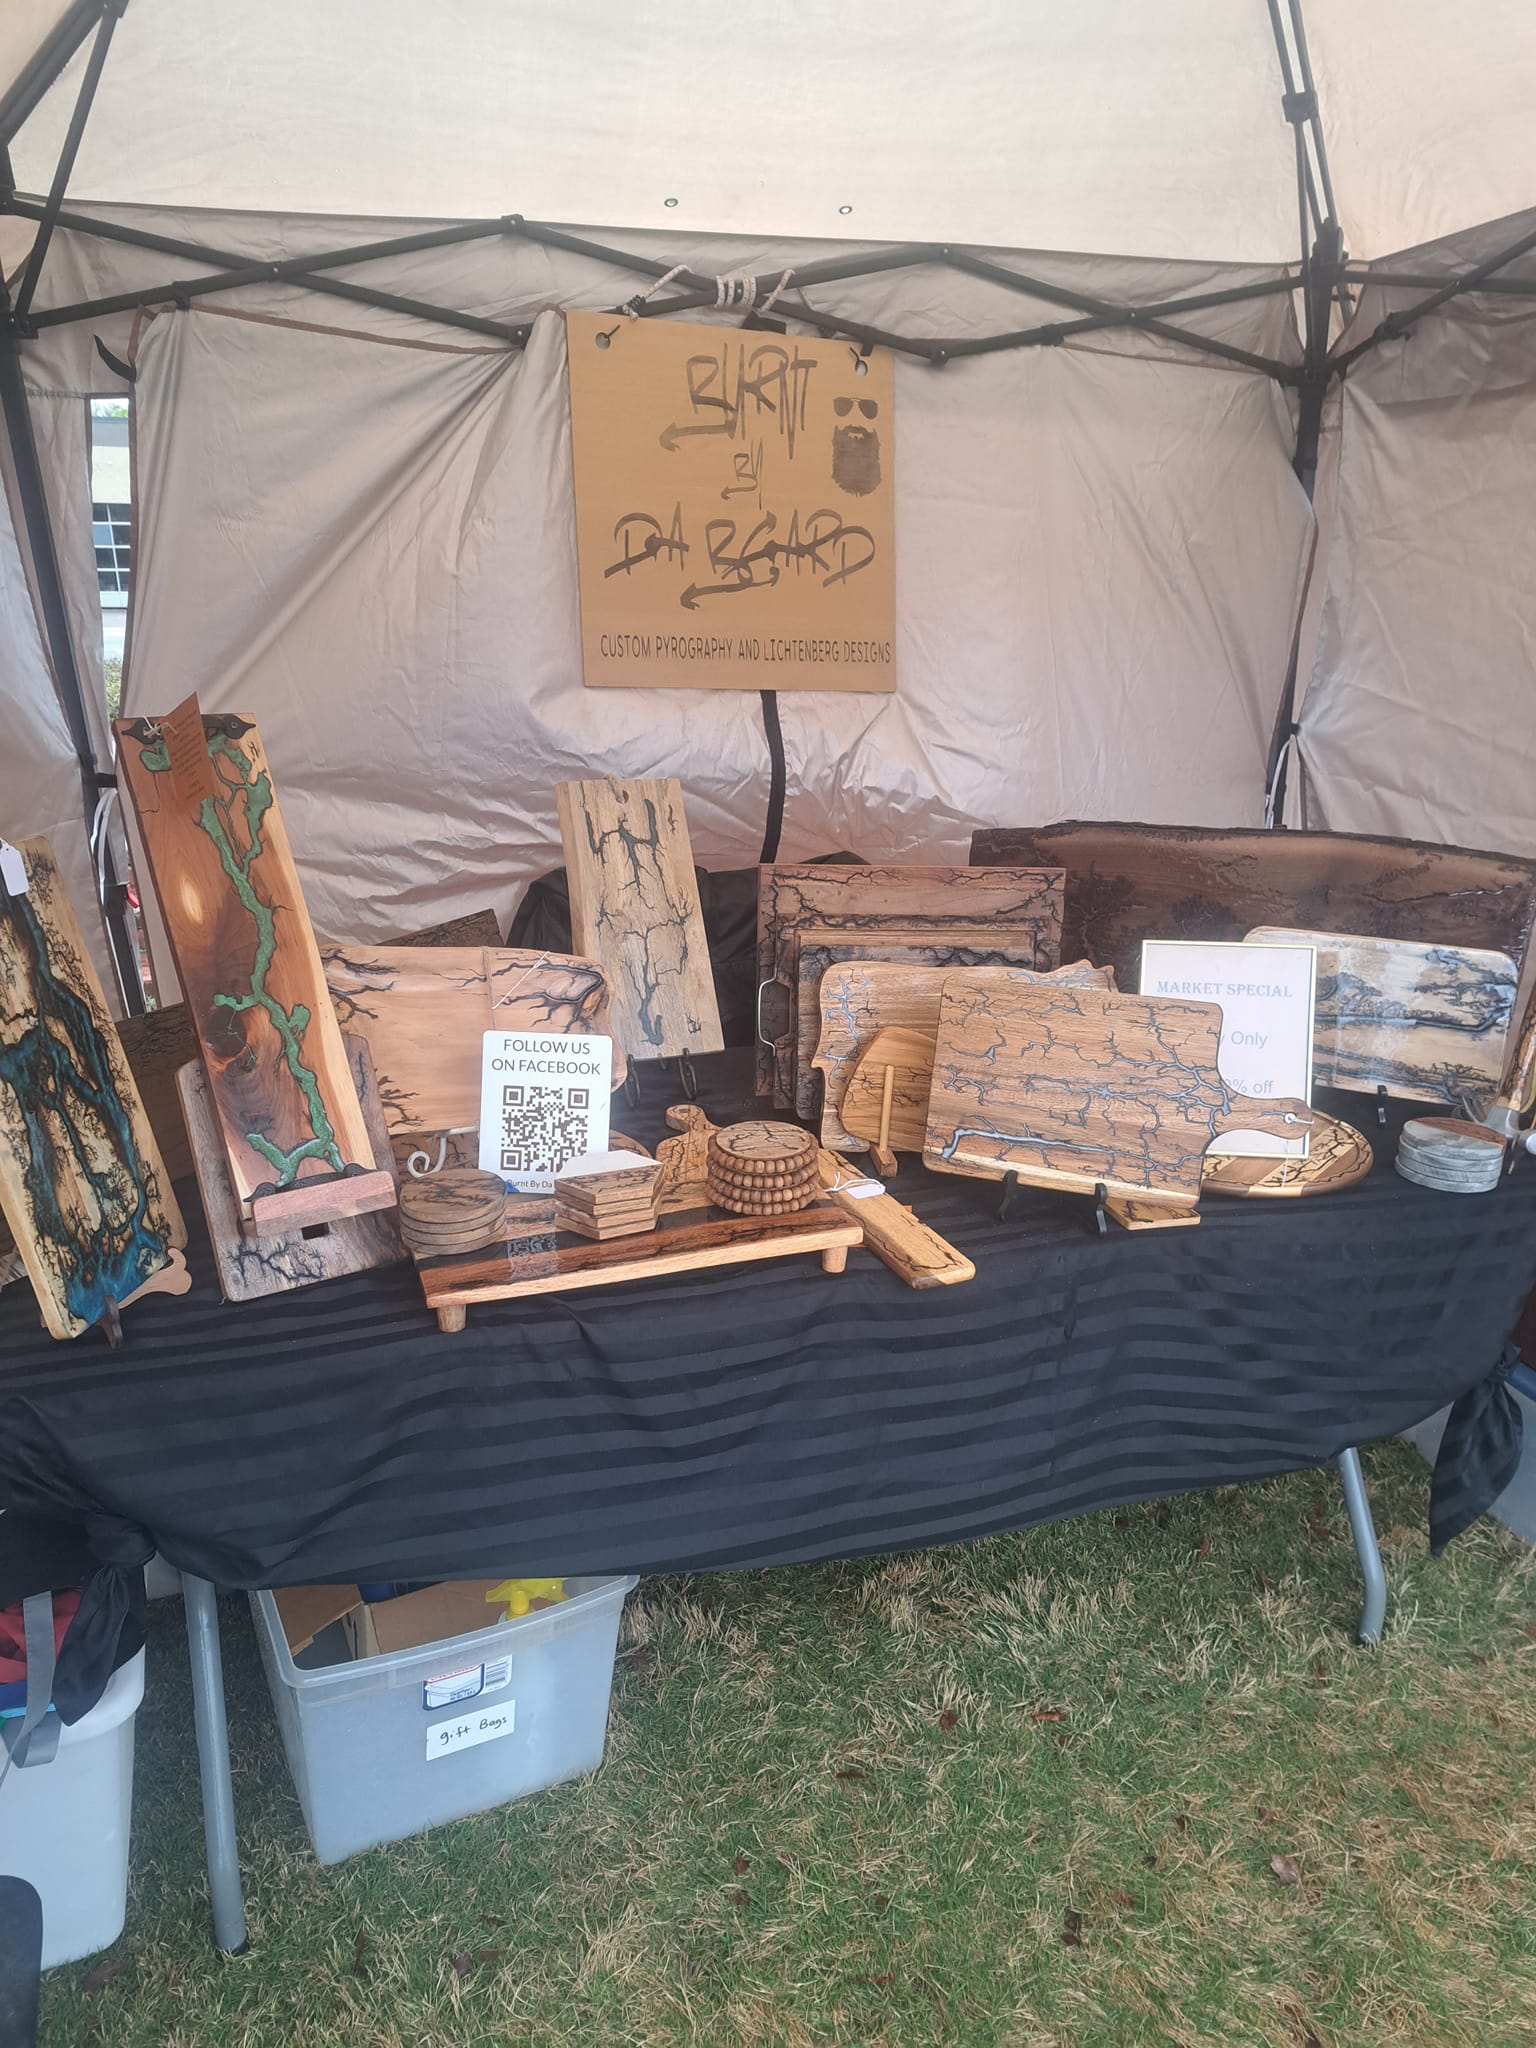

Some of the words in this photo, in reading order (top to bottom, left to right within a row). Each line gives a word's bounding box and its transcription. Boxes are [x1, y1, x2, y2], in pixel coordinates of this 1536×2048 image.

[660, 343, 818, 460] BURNT
[721, 438, 763, 511] BY
[604, 501, 690, 579] DA
[600, 634, 651, 658] CUSTOM
[655, 636, 733, 660] PYROGRAPHY
[738, 639, 760, 661] AND
[763, 639, 840, 662] LICHTENBERG
[844, 641, 891, 663] DESIGNS
[1157, 981, 1223, 995] MARKET
[1226, 984, 1293, 998] SPECIAL
[504, 1039, 568, 1054] FOLLOW
[571, 1042, 591, 1055] US
[1231, 1031, 1268, 1049] Only
[491, 1058, 515, 1072] ON
[519, 1060, 601, 1075] FACEBOOK
[1253, 1080, 1273, 1094] off
[530, 1180, 540, 1189] By
[440, 1726, 471, 1746] gift
[479, 1717, 508, 1730] Bags
